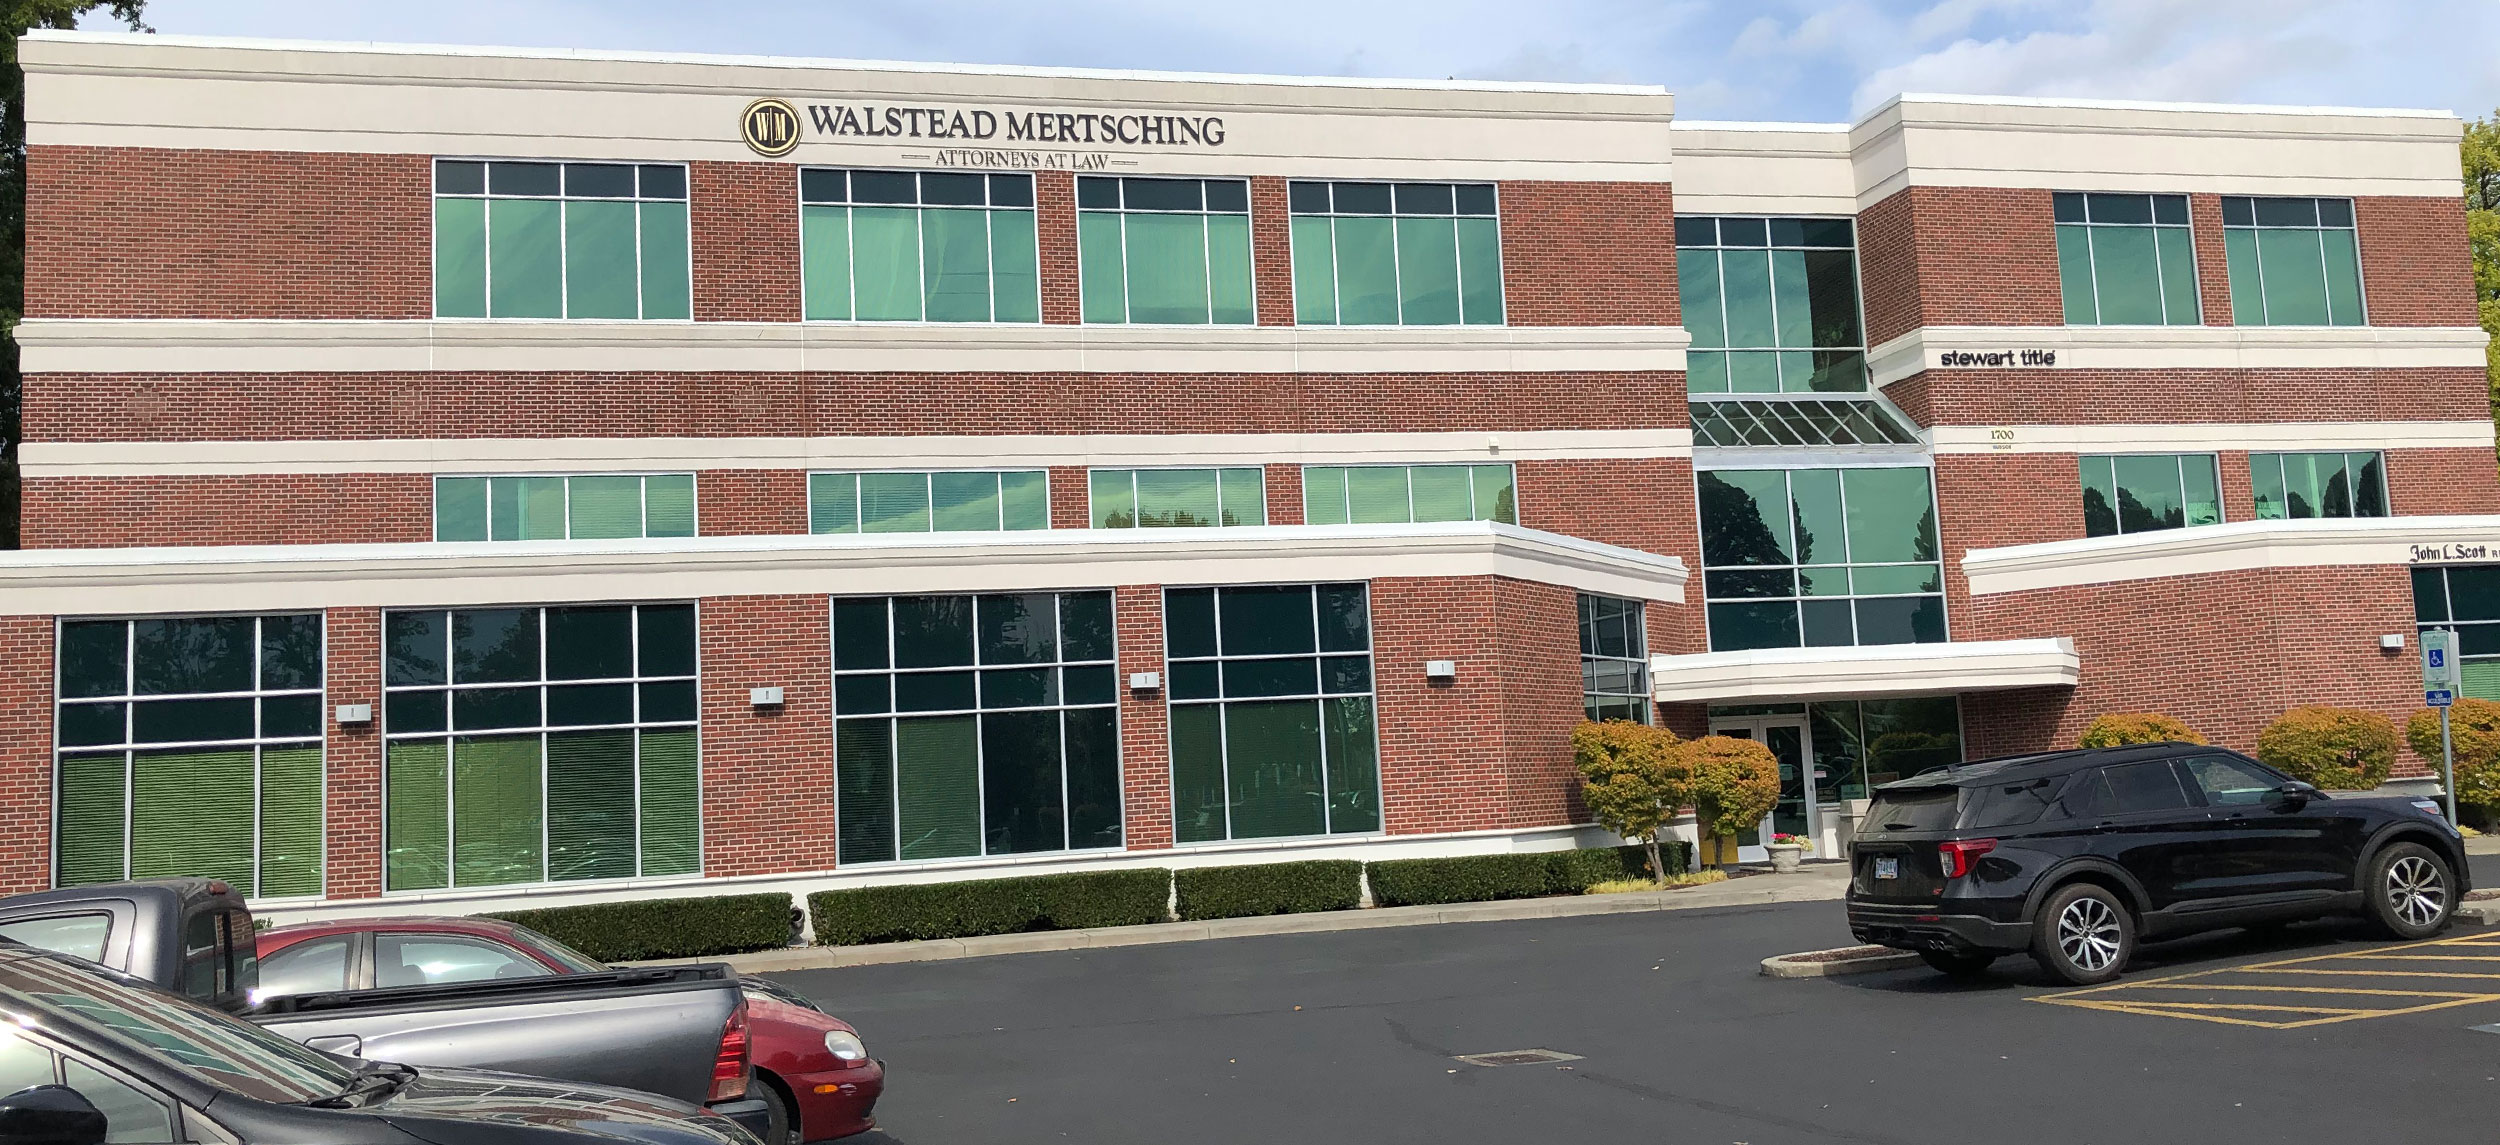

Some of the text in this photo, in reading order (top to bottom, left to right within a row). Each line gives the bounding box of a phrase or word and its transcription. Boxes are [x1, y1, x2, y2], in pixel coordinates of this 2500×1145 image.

[808, 104, 1225, 146] WALSTEAD MERTSCHING
[935, 150, 1109, 170] ATTORNEYS AT LAW
[1940, 349, 2056, 366] stewart title
[1991, 430, 2014, 439] 1700
[2409, 545, 2440, 562] John
